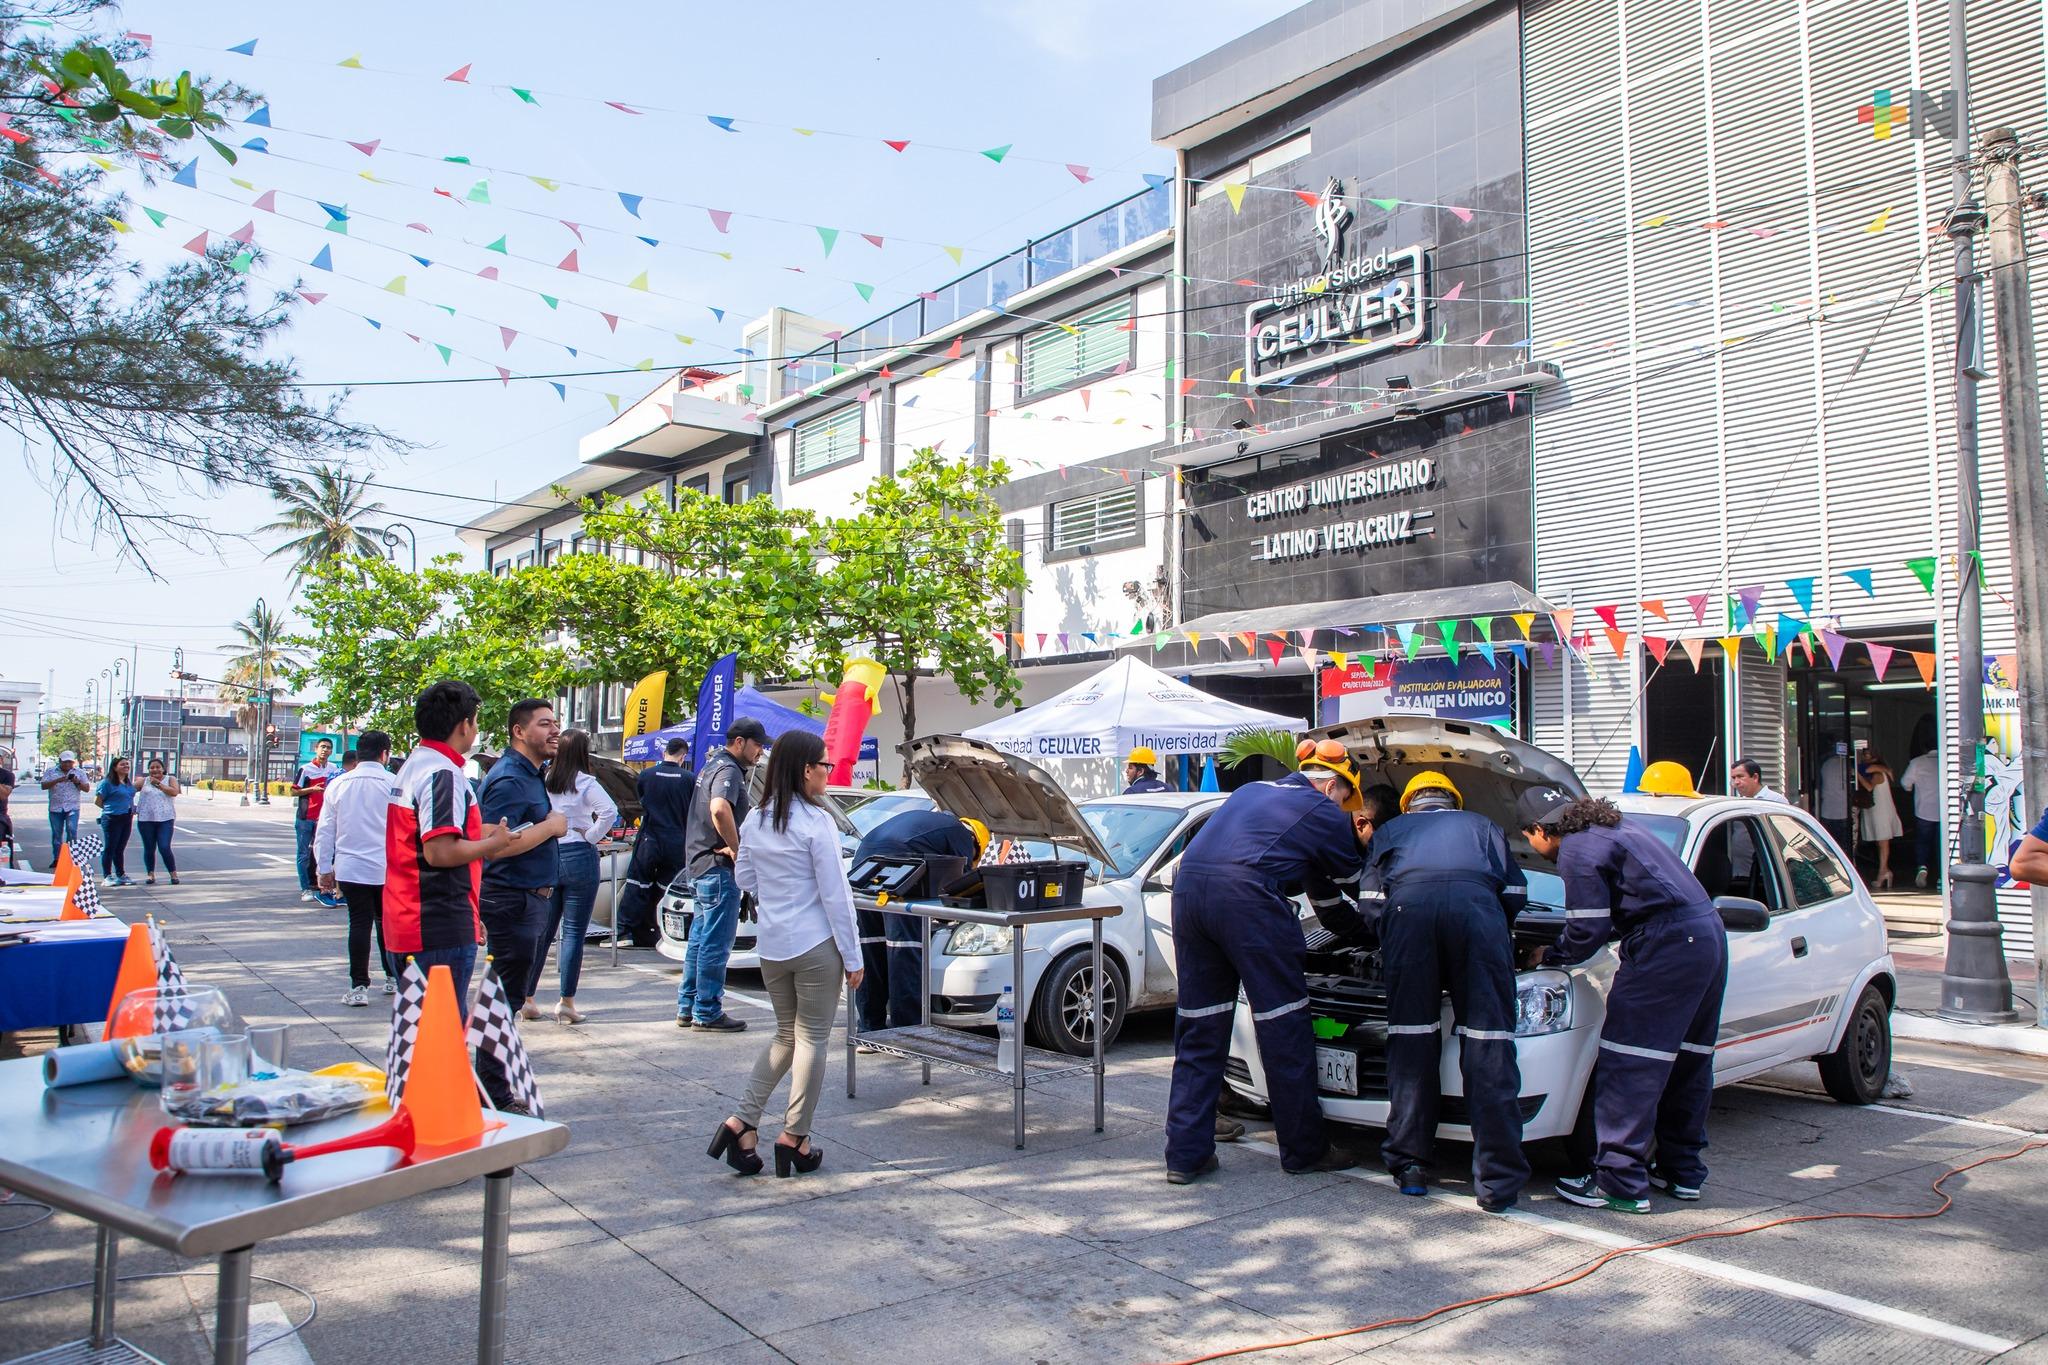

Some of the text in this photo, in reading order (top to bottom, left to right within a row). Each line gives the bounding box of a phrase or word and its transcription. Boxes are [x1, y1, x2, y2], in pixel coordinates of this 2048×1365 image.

[1257, 279, 1411, 358] CEULVER
[1247, 458, 1432, 518] CENTRO UNIVERSITARIO
[1263, 510, 1412, 560] LATINO VERACRUZ
[1394, 689, 1506, 709] EXAMEN ÚNICO
[1399, 678, 1502, 693] INSTITUCIÓN EVALUADORA
[637, 698, 649, 735] RUVER
[712, 674, 723, 731] GRUVER
[1040, 738, 1101, 755] CEULVER
[1133, 731, 1218, 751] Universidad
[1018, 879, 1036, 899] 01
